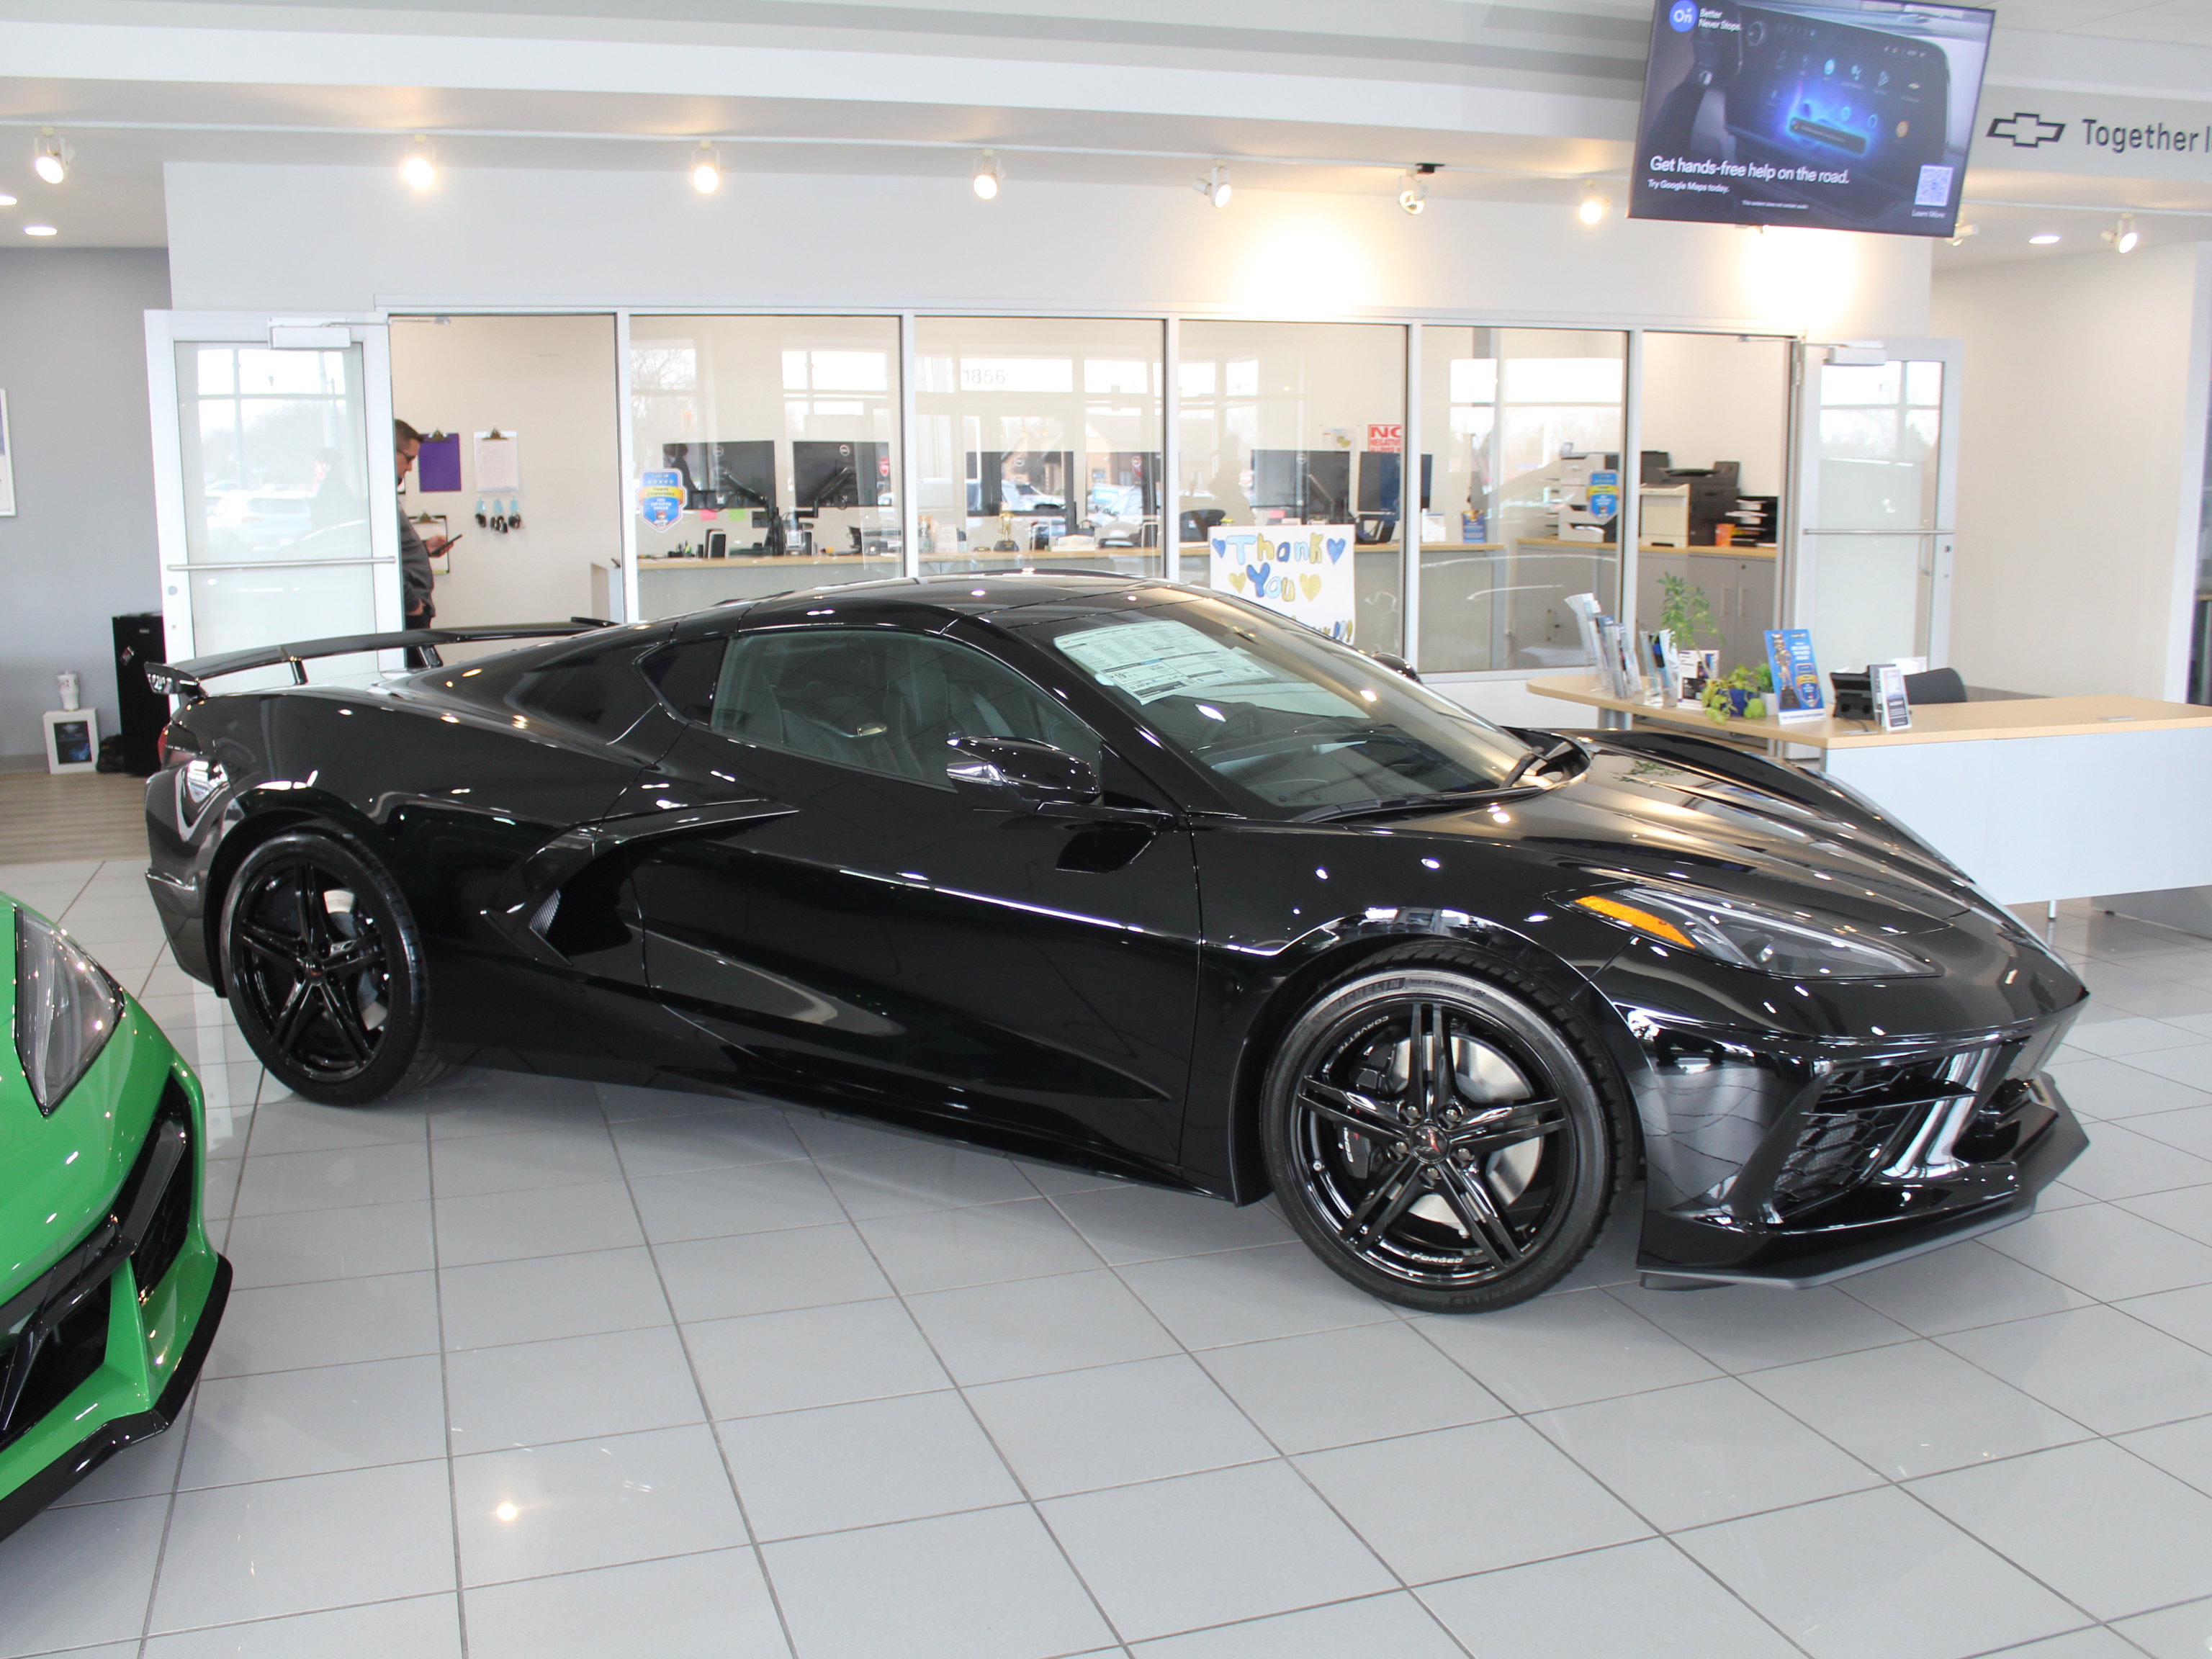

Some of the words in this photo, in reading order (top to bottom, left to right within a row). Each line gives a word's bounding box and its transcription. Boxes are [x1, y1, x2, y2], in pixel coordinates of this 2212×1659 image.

[2082, 118, 2198, 153] Together
[1650, 155, 1676, 172] Get
[1676, 157, 1747, 177] hands-free
[1748, 162, 1777, 181] help
[1777, 168, 1796, 180] on
[1796, 166, 1818, 181] the
[1818, 168, 1851, 184] road.
[1660, 179, 1686, 192] Google
[962, 369, 1006, 385] 1856
[1226, 533, 1324, 566] Thank
[1246, 562, 1295, 602] You
[1330, 978, 1401, 1012] MICHELIN
[1339, 1015, 1390, 1054] CORVETTE
[1411, 1253, 1465, 1264] FORGED
